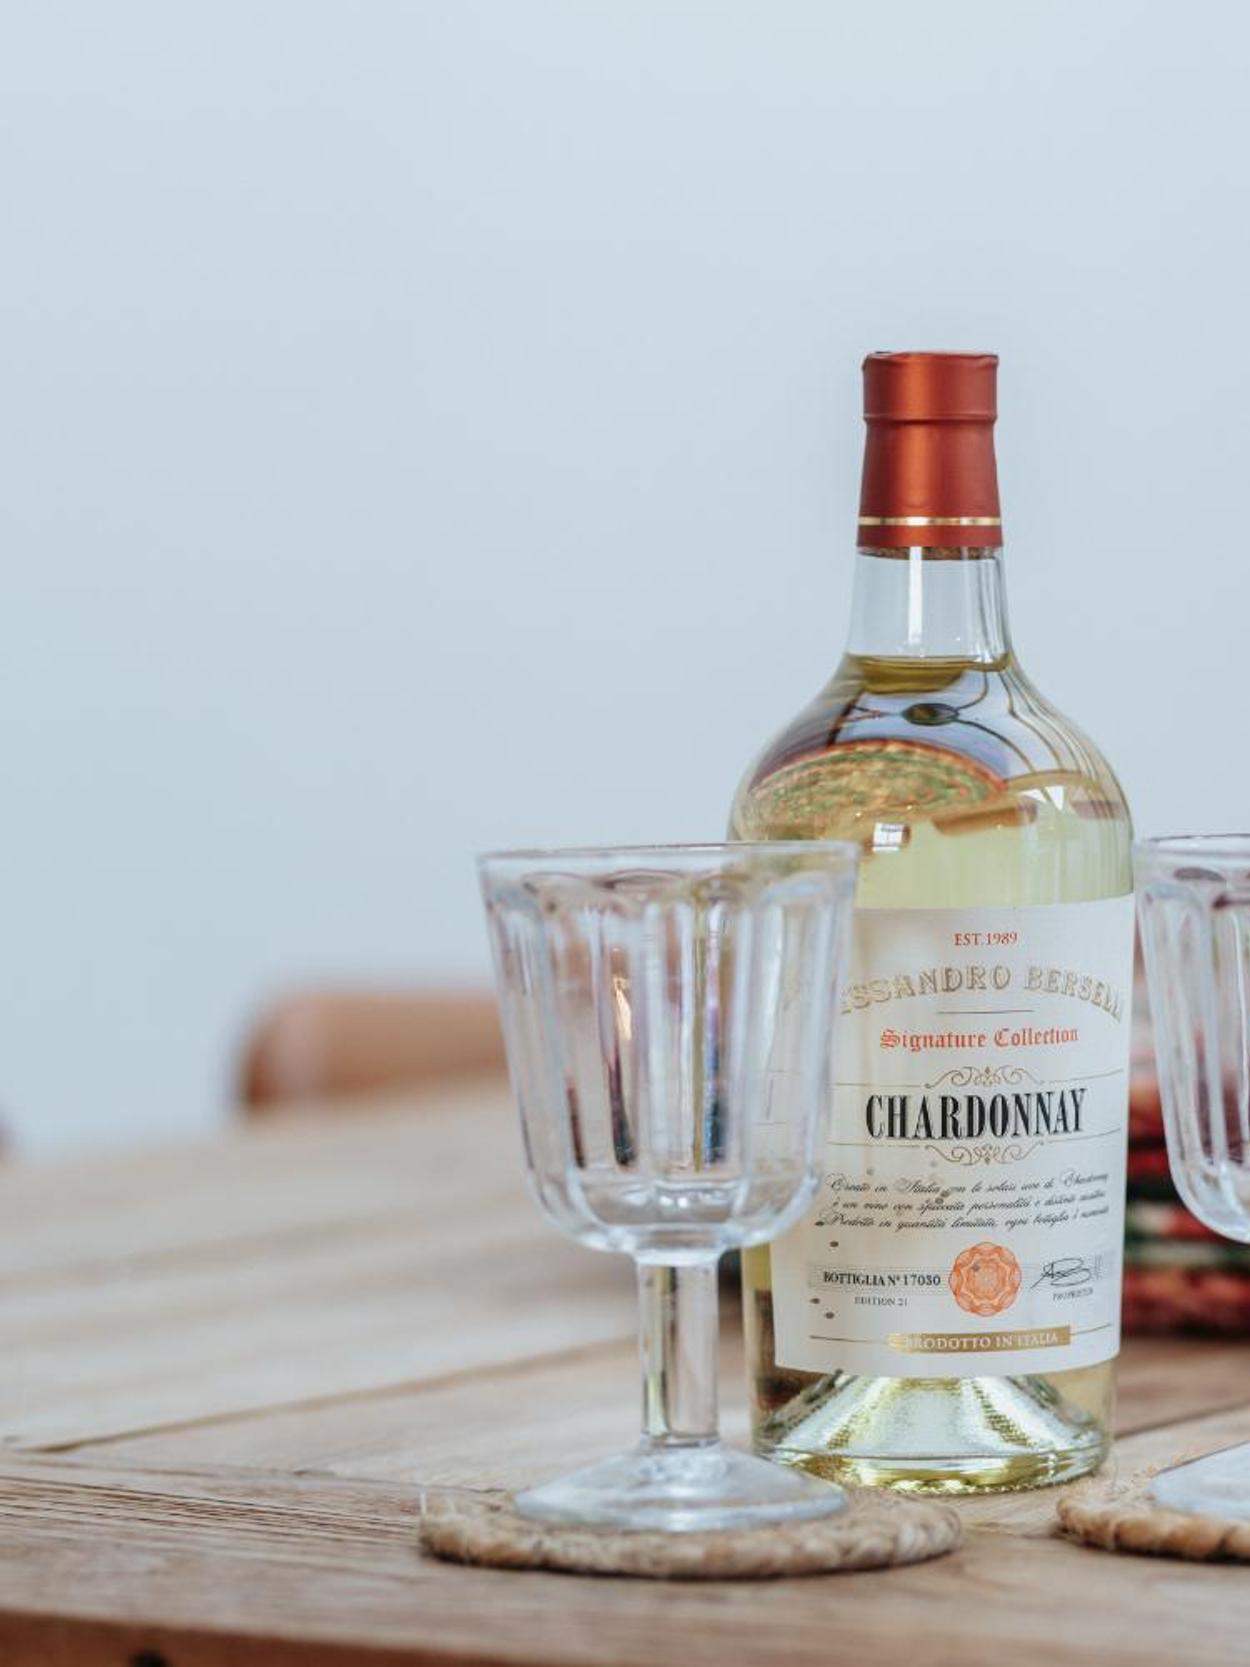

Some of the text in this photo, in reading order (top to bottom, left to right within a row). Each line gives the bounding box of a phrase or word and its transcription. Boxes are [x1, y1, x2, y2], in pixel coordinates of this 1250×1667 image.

[879, 1027, 1080, 1052] Signature Collection
[866, 1088, 1088, 1140] CHARDONNAY
[823, 1271, 886, 1287] BOTTIGLIA
[995, 1336, 1013, 1349] IN
[1017, 1332, 1060, 1347] ITALIA
